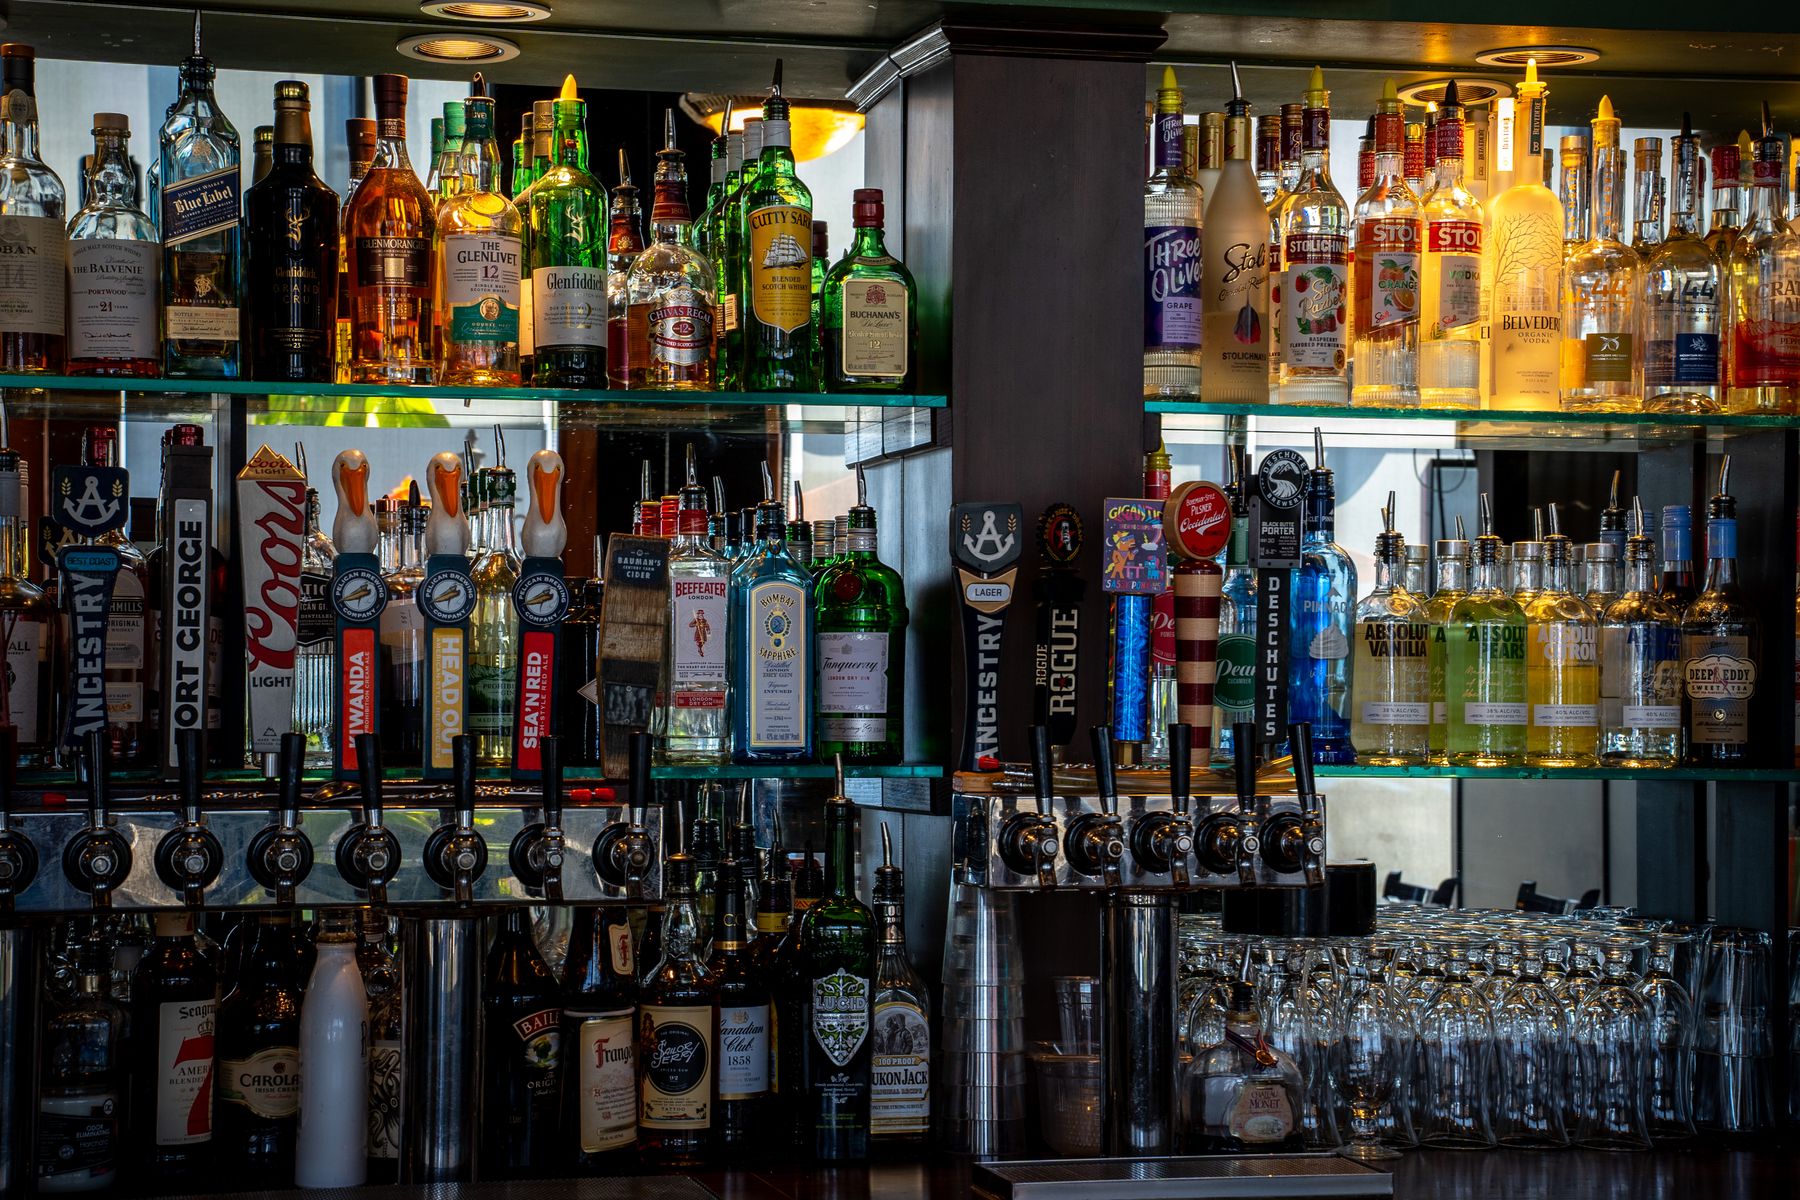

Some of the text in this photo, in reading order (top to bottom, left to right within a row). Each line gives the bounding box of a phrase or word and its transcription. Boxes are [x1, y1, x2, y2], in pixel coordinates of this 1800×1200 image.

[1533, 100, 1541, 136] BELVEDERE
[173, 186, 233, 215] Blue Label
[752, 211, 787, 230] CUTTY
[0, 245, 37, 255] BAN
[362, 238, 426, 250] GLENMORANGIE
[482, 241, 500, 250] THE
[457, 250, 518, 266] GLENLIVET
[1222, 242, 1266, 284] Stoli
[2, 264, 26, 289] 14
[73, 263, 142, 275] THE BALVENIE
[482, 265, 499, 279] 12
[1450, 270, 1481, 280] VODKA
[547, 272, 604, 290] Glenfiddich
[761, 283, 808, 291] SCOTCH WHISKY
[1378, 279, 1418, 290] ORANGE
[88, 288, 127, 297] PORTWOOD
[100, 301, 113, 312] 21
[1166, 302, 1193, 310] GRAPE
[649, 307, 712, 325] CHIVAS REGAL
[850, 310, 901, 319] BUCHANAN'S
[679, 323, 690, 334] 12
[1503, 314, 1560, 332] BELVEDER
[869, 340, 881, 349] 12
[249, 458, 293, 470] Coors
[1263, 451, 1310, 476] DESCHUTES
[1266, 493, 1303, 507] BREWERY
[1191, 502, 1213, 517] PILSNER
[1180, 506, 1228, 533] Occidental
[1261, 527, 1295, 535] PORTER
[617, 556, 662, 567] BAUMAN'S
[248, 480, 306, 672] Coors
[626, 570, 651, 579] CIDER
[176, 519, 203, 652] GEORGE
[335, 571, 360, 596] PELICAN
[360, 571, 385, 598] BREWING
[425, 573, 474, 599] PELICAN BREWING
[518, 576, 567, 604] PELICAN BREWING
[675, 581, 727, 598] BEEFEATER
[974, 588, 1002, 597] LAGER
[110, 601, 143, 613] HMILLS
[760, 593, 797, 609] BOMBAY
[342, 607, 377, 619] COMPANY
[432, 608, 467, 619] COMPANY
[525, 611, 559, 623] COMPANY
[1365, 623, 1429, 641] ABSOLUT
[73, 572, 106, 738] ANCESTRY
[758, 646, 801, 661] SAPPHIRE
[1264, 576, 1281, 738] DESCHUTES
[1369, 641, 1428, 658] VANILIA
[1482, 642, 1525, 660] PEARS
[1543, 643, 1598, 661] CITRON
[823, 656, 880, 674] Tanqueray
[1036, 643, 1048, 687] ROGUE
[1050, 608, 1079, 716] ROGUE
[1216, 658, 1257, 681] Pear
[441, 637, 460, 705] HEAD
[1690, 668, 1750, 681] DEEP EDDY
[252, 675, 293, 688] LIGHT
[976, 613, 1004, 760] ANCESTRY
[348, 651, 365, 749] KIWANDA
[522, 651, 542, 751] SEA'N RED
[815, 995, 867, 1011] LUCID
[724, 1036, 754, 1053] Club
[728, 1055, 751, 1066] 1858
[880, 1057, 914, 1065] 100 PROOF
[872, 1068, 929, 1086] UKON JACK
[1250, 1099, 1281, 1109] MONET
